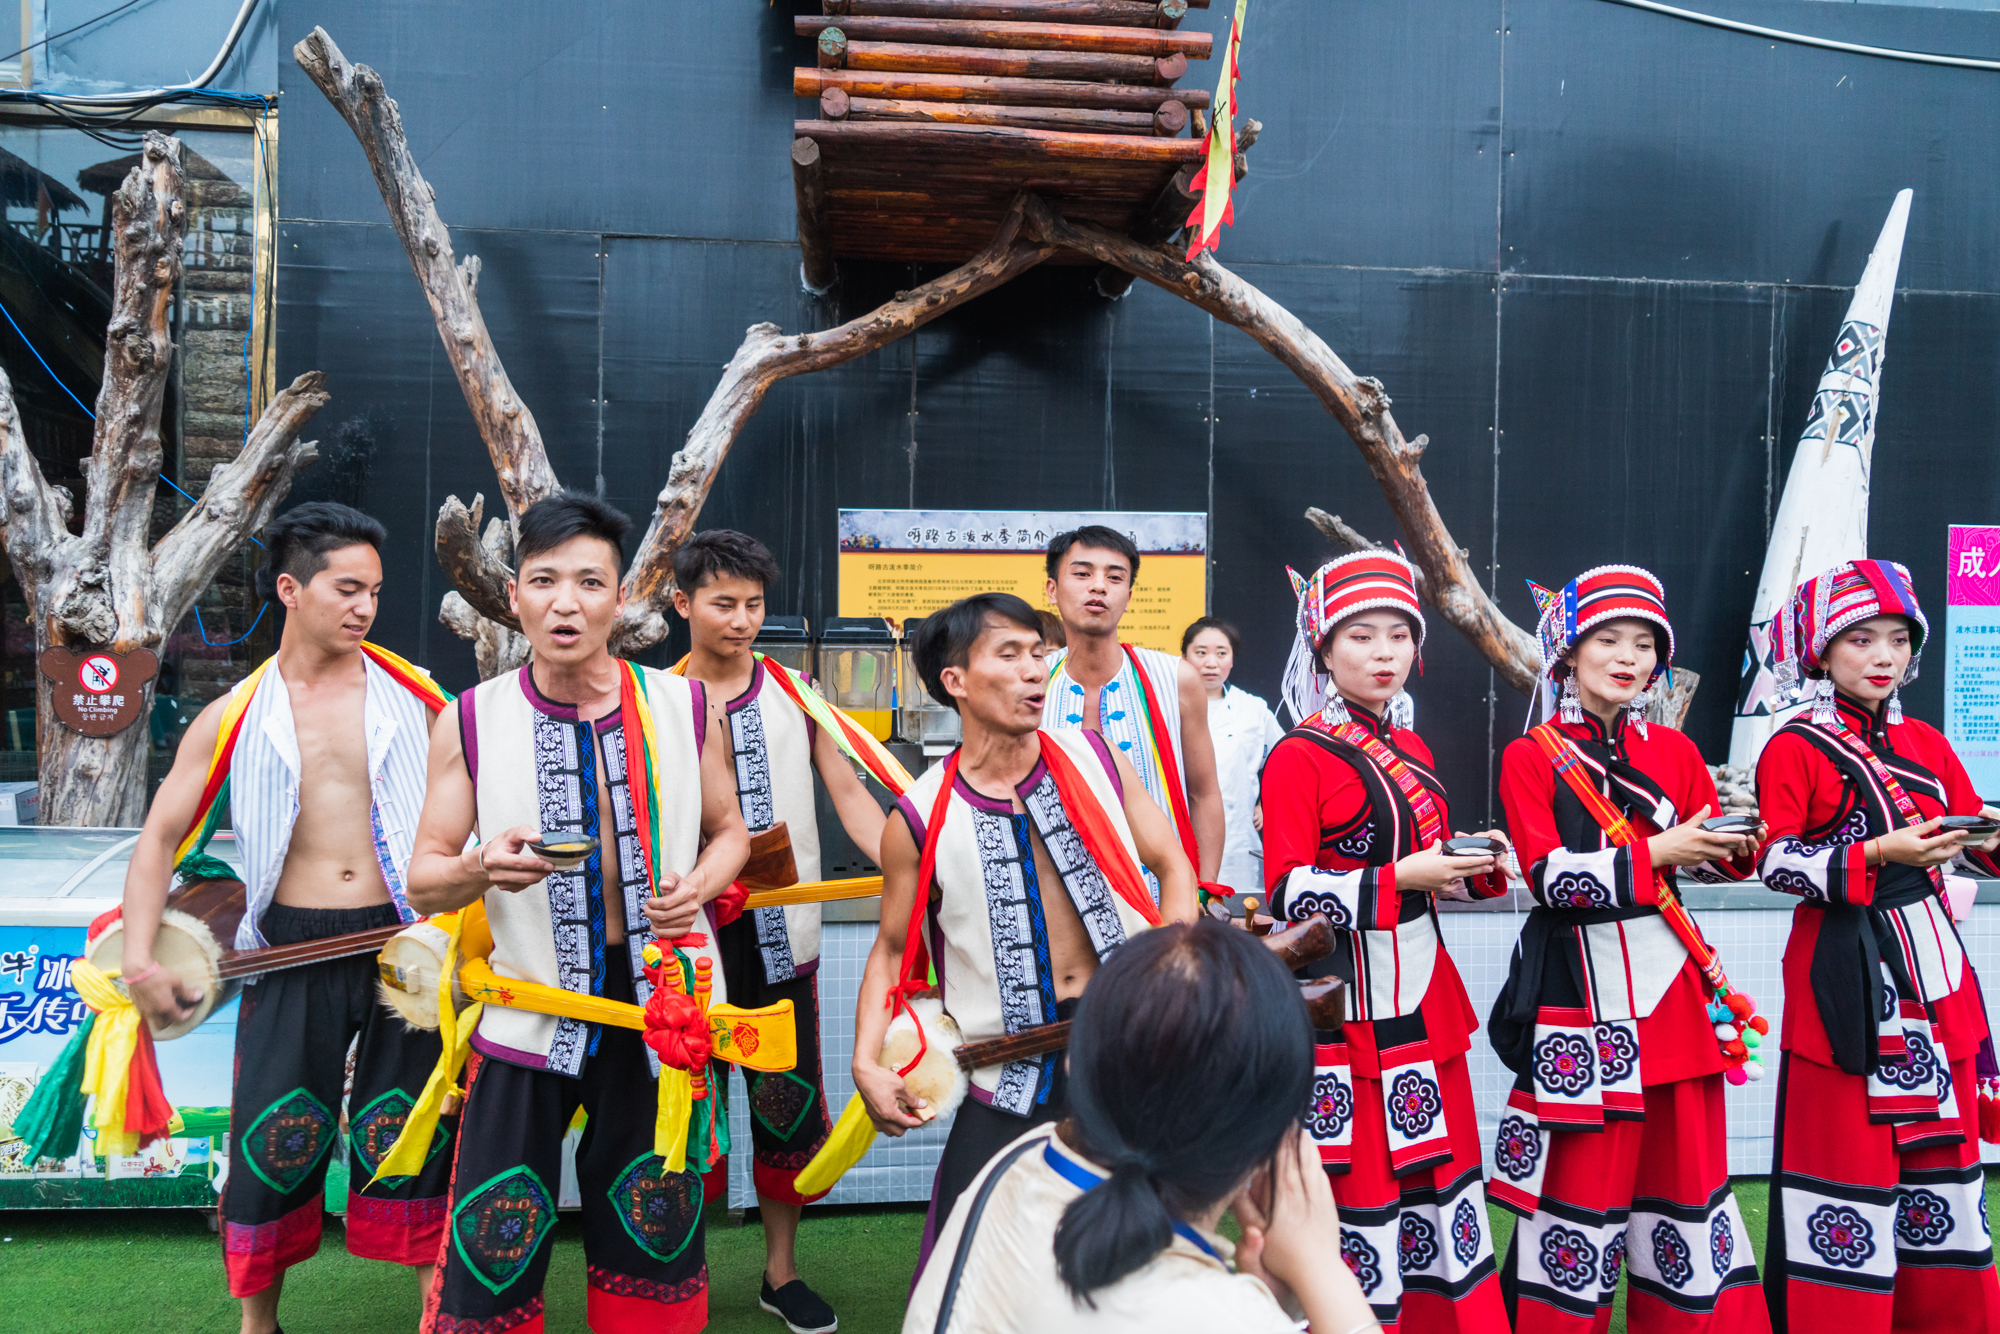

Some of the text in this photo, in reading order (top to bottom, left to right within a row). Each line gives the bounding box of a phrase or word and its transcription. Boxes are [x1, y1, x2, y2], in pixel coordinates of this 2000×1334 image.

[868, 563, 924, 571] 呀路古泼水季简介
[73, 694, 124, 706] 禁止攀爬
[88, 706, 118, 714] Climbing
[2, 952, 35, 983] 牛
